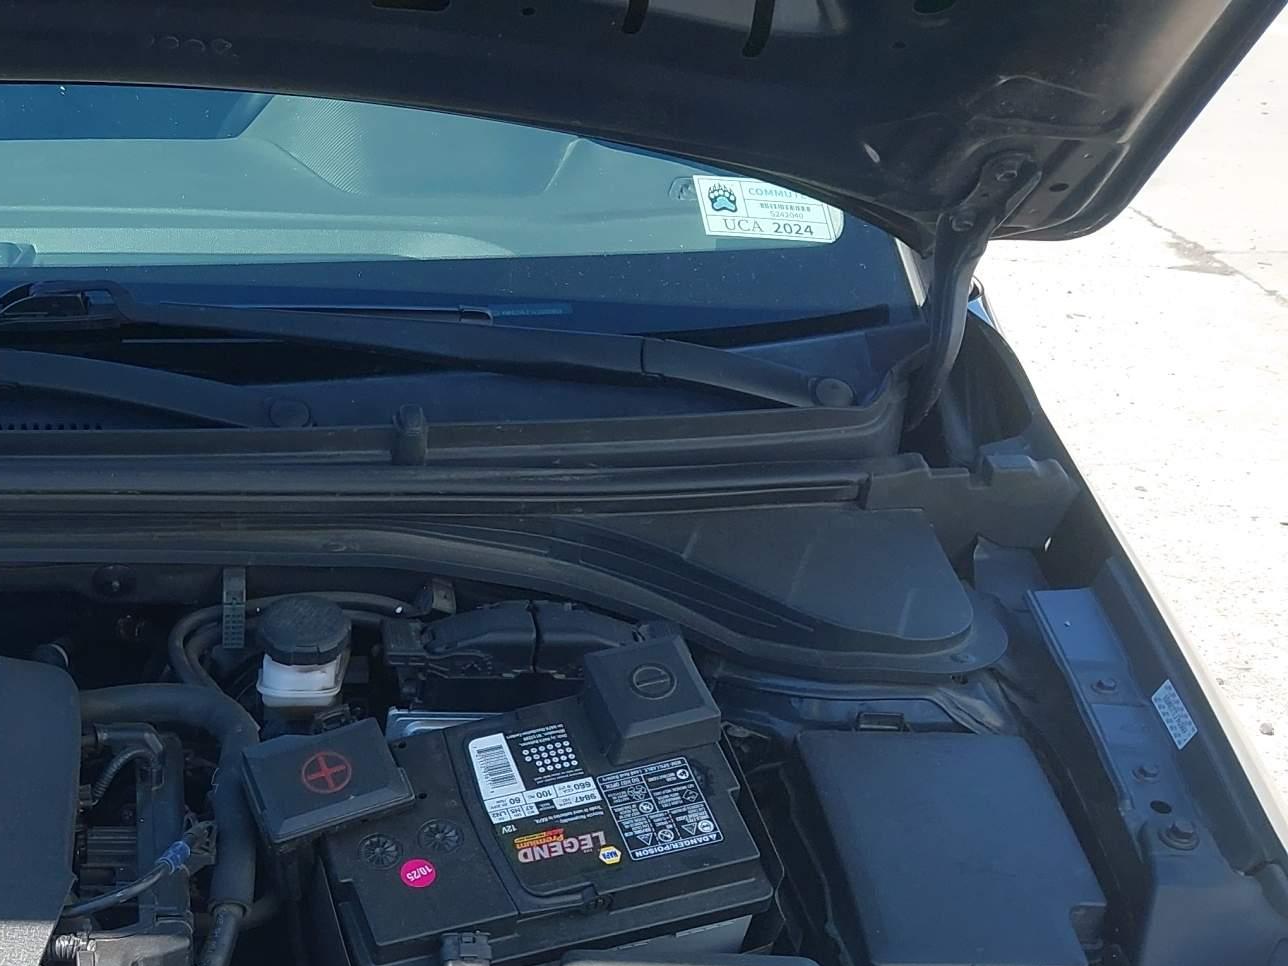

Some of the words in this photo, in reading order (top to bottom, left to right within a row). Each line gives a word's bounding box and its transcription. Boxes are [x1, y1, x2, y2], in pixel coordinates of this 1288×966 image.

[723, 218, 764, 233] UCA
[772, 222, 814, 236] 2024
[573, 781, 592, 791] 660
[509, 796, 521, 805] 60
[536, 789, 553, 799] 100
[575, 793, 597, 804] 9847
[501, 824, 518, 835] 12V
[516, 833, 565, 850] Premium
[517, 831, 607, 863] LEGEND
[635, 835, 710, 858] DANGER/POISON
[405, 865, 433, 882] 10/25
